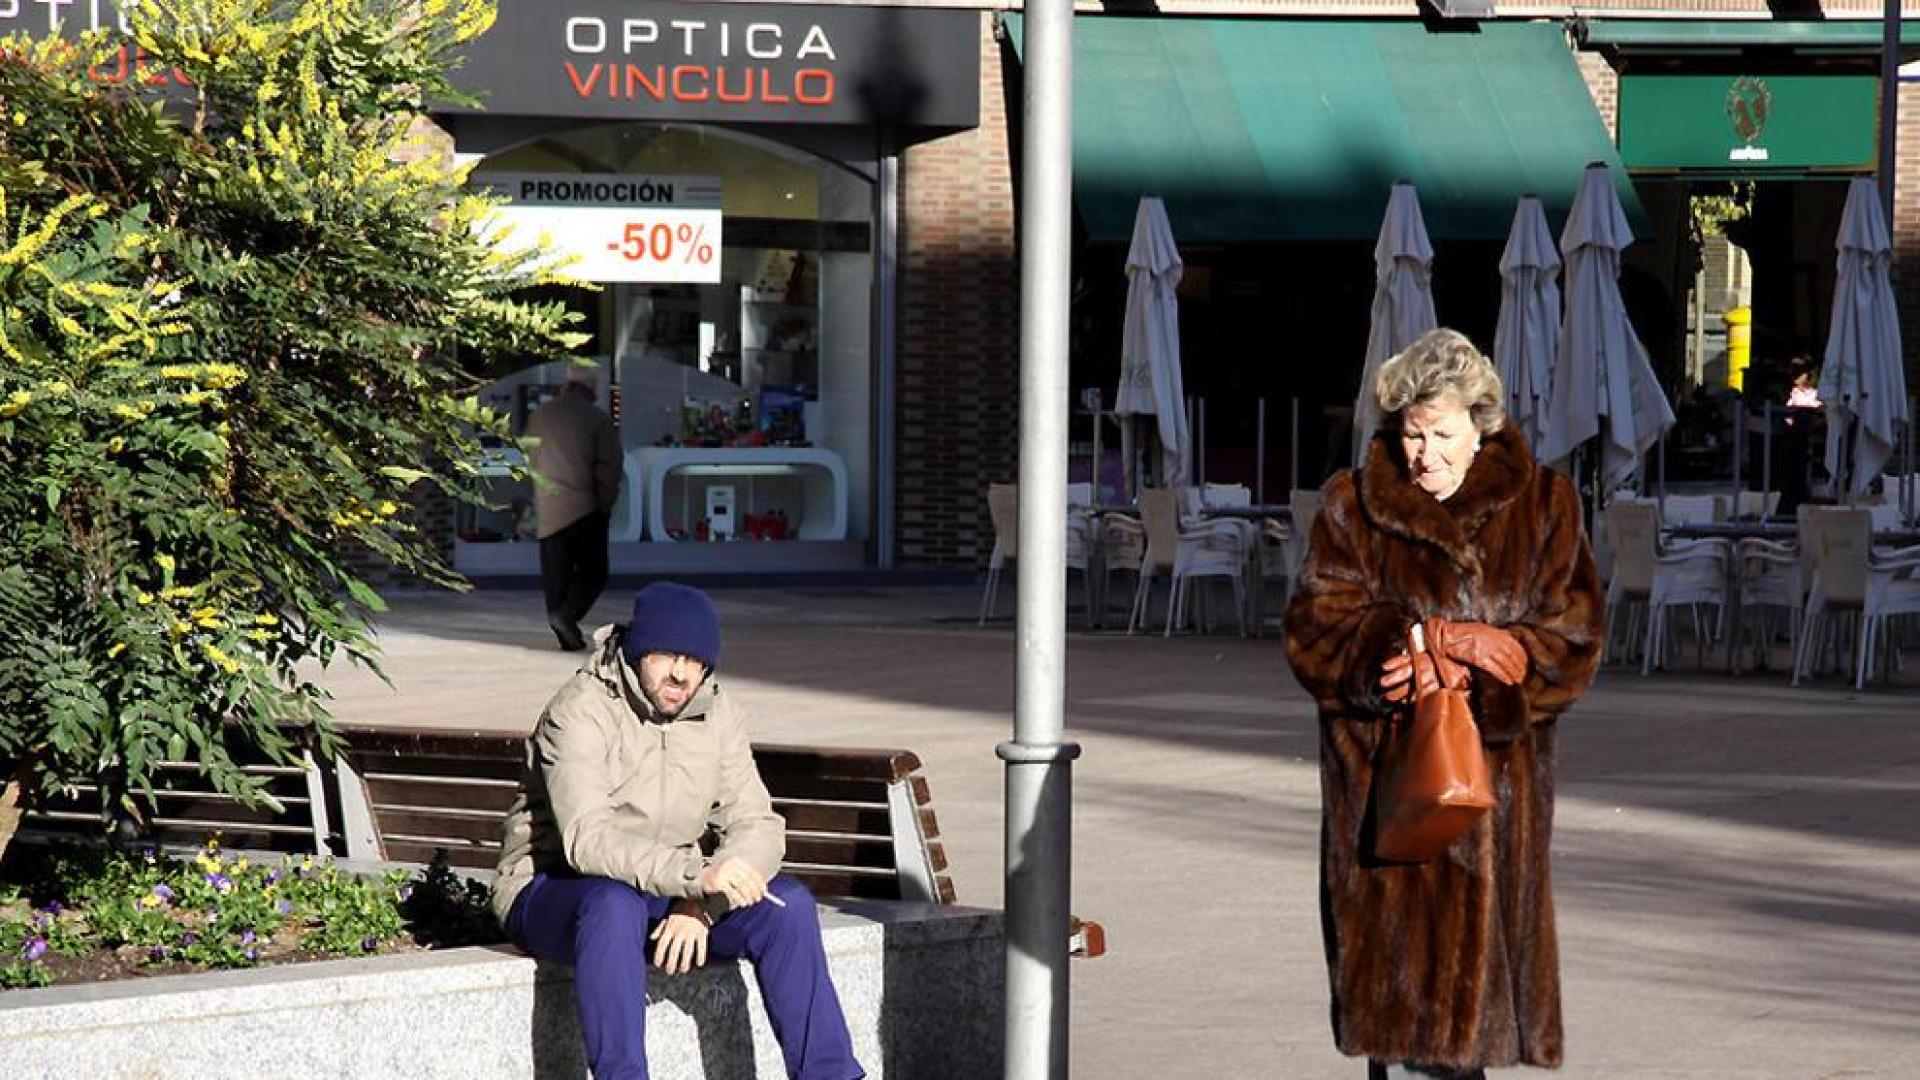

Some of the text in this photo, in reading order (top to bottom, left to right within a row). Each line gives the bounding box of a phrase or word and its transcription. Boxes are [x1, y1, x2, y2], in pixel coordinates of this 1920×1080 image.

[566, 17, 836, 60] OPTICA
[564, 61, 835, 104] VINCULO
[520, 179, 674, 202] PROMOCIÓN
[606, 222, 713, 265] -50%
